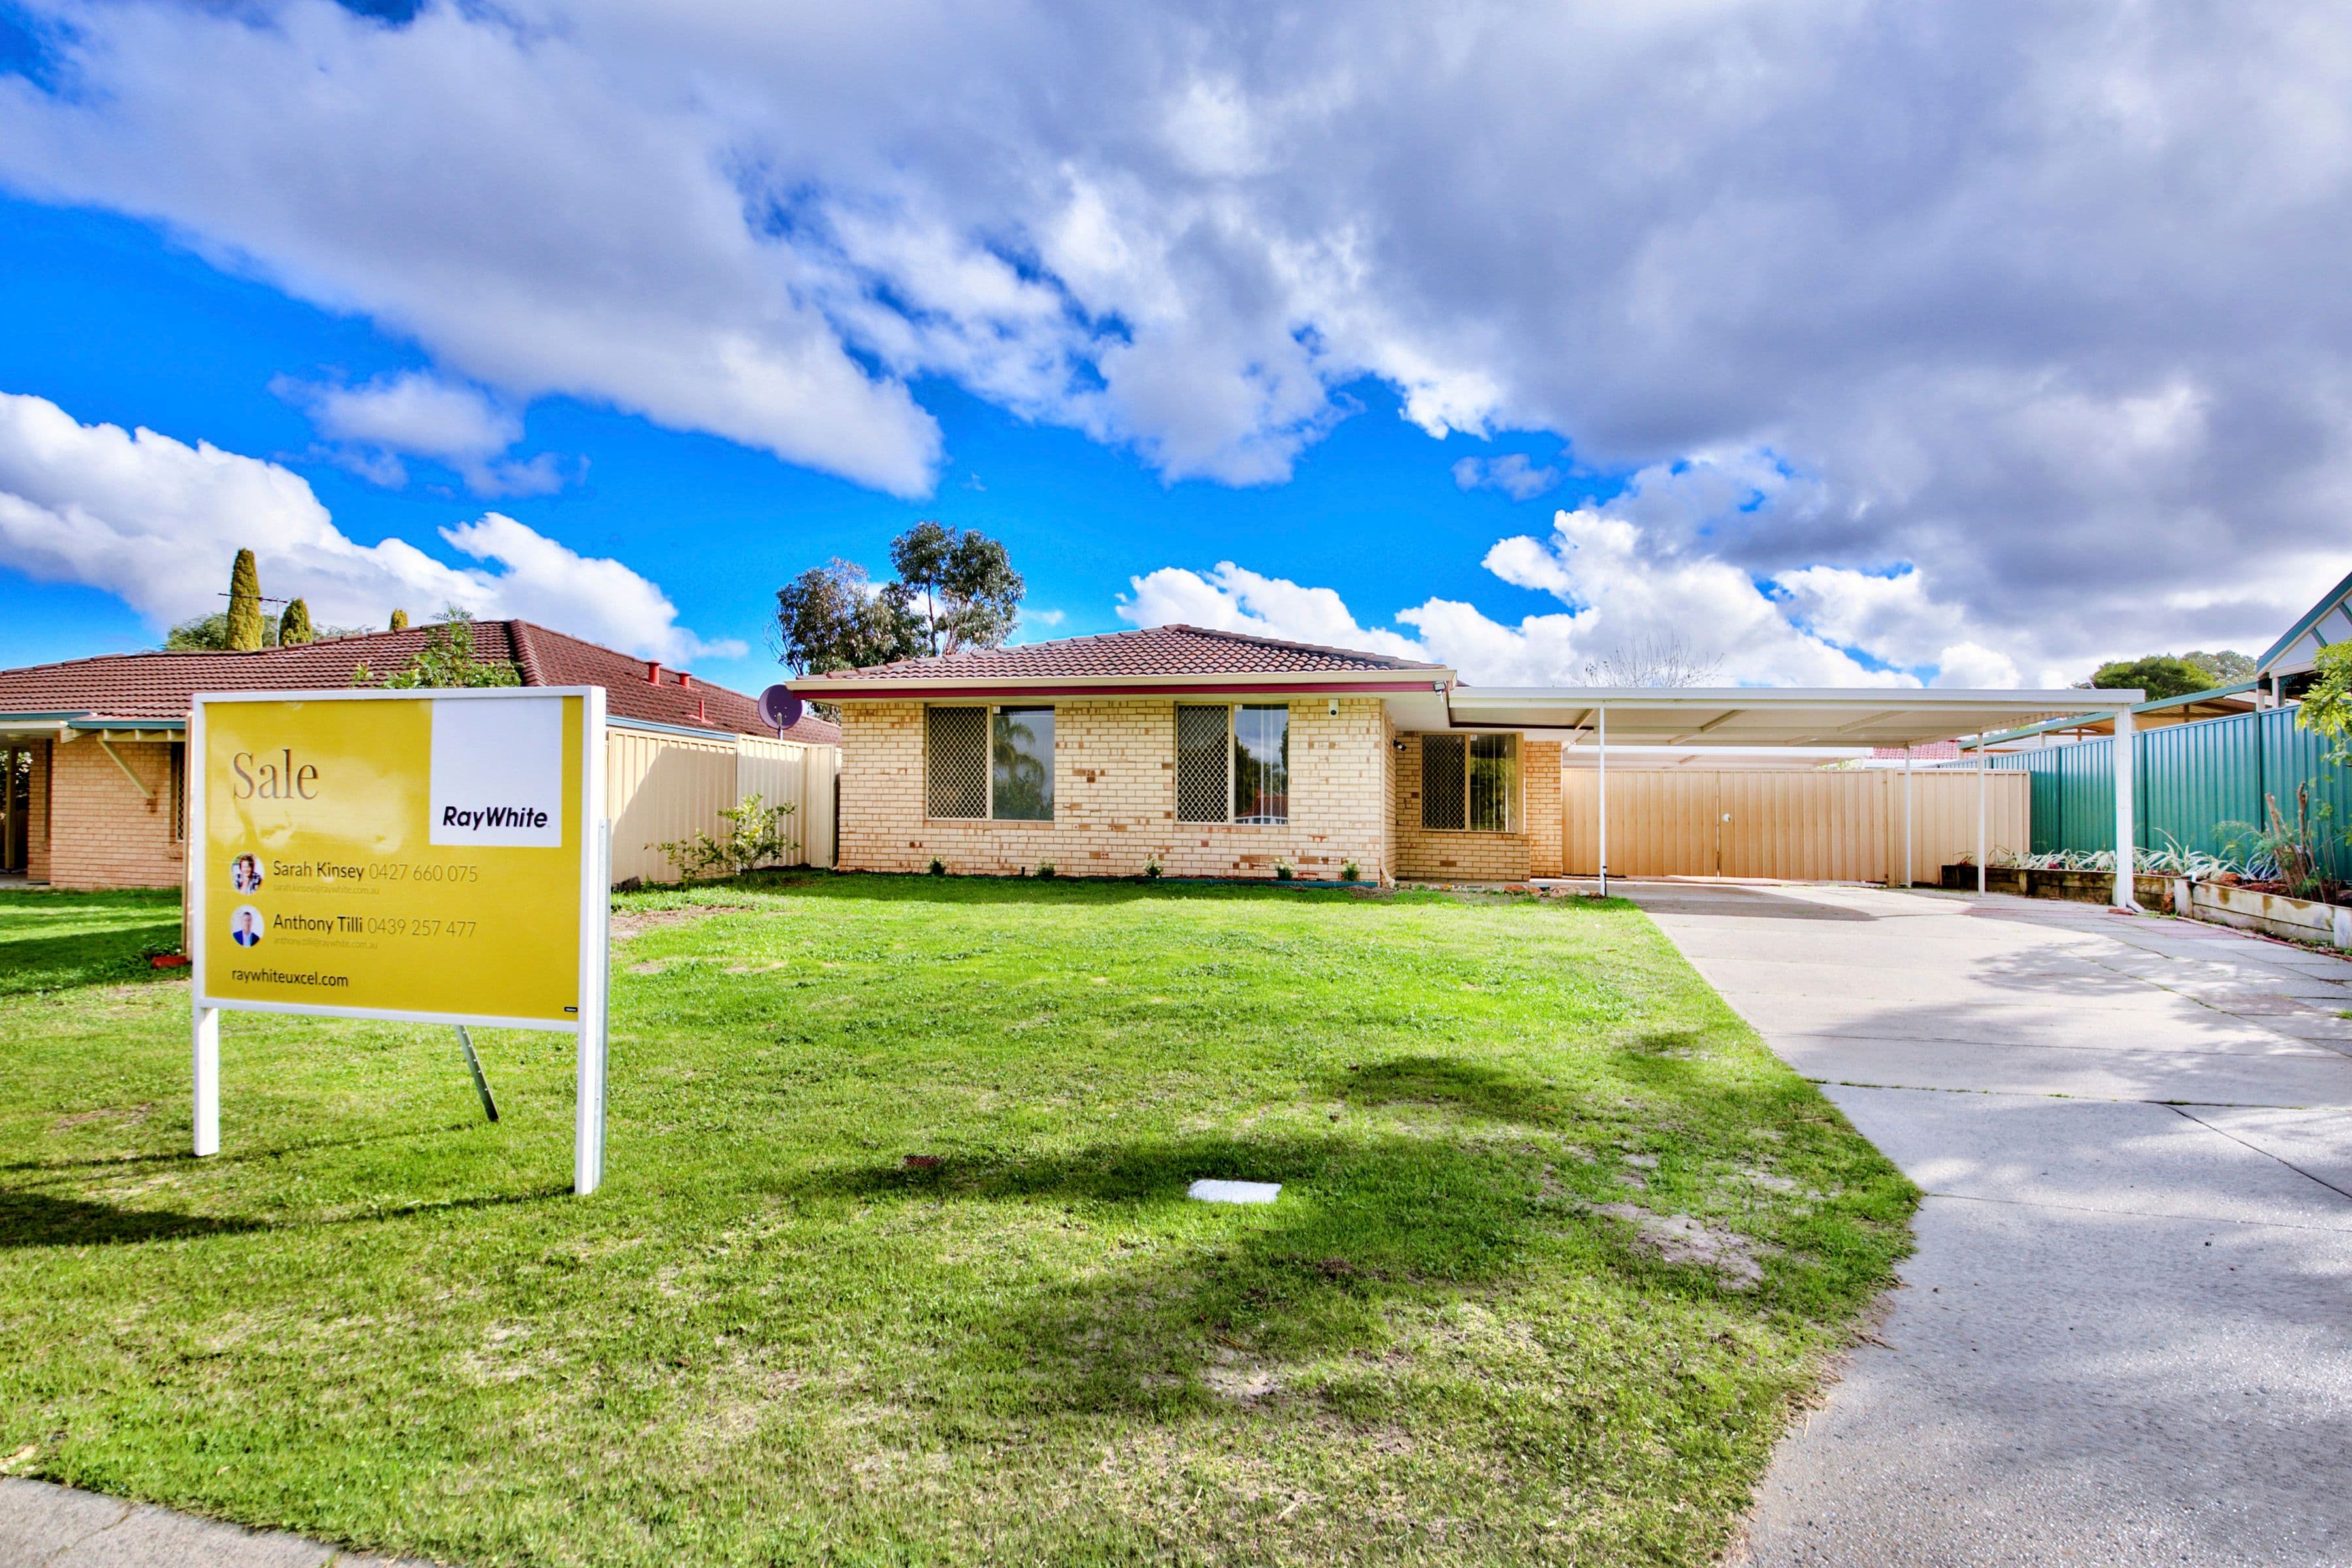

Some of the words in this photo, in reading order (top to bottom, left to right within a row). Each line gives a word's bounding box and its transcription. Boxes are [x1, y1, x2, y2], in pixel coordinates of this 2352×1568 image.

[233, 749, 319, 800] Sale
[273, 860, 312, 877] Sarah
[317, 861, 365, 882] Kinsey
[368, 863, 408, 880] 0427
[413, 865, 443, 881] 660
[447, 865, 478, 883] 075
[273, 913, 334, 935] Anthony
[337, 916, 363, 933] Tilli
[367, 917, 406, 935] 0439
[412, 919, 441, 936] 257
[446, 921, 476, 938] 477
[231, 968, 349, 987] raywhiteuxcel.com
